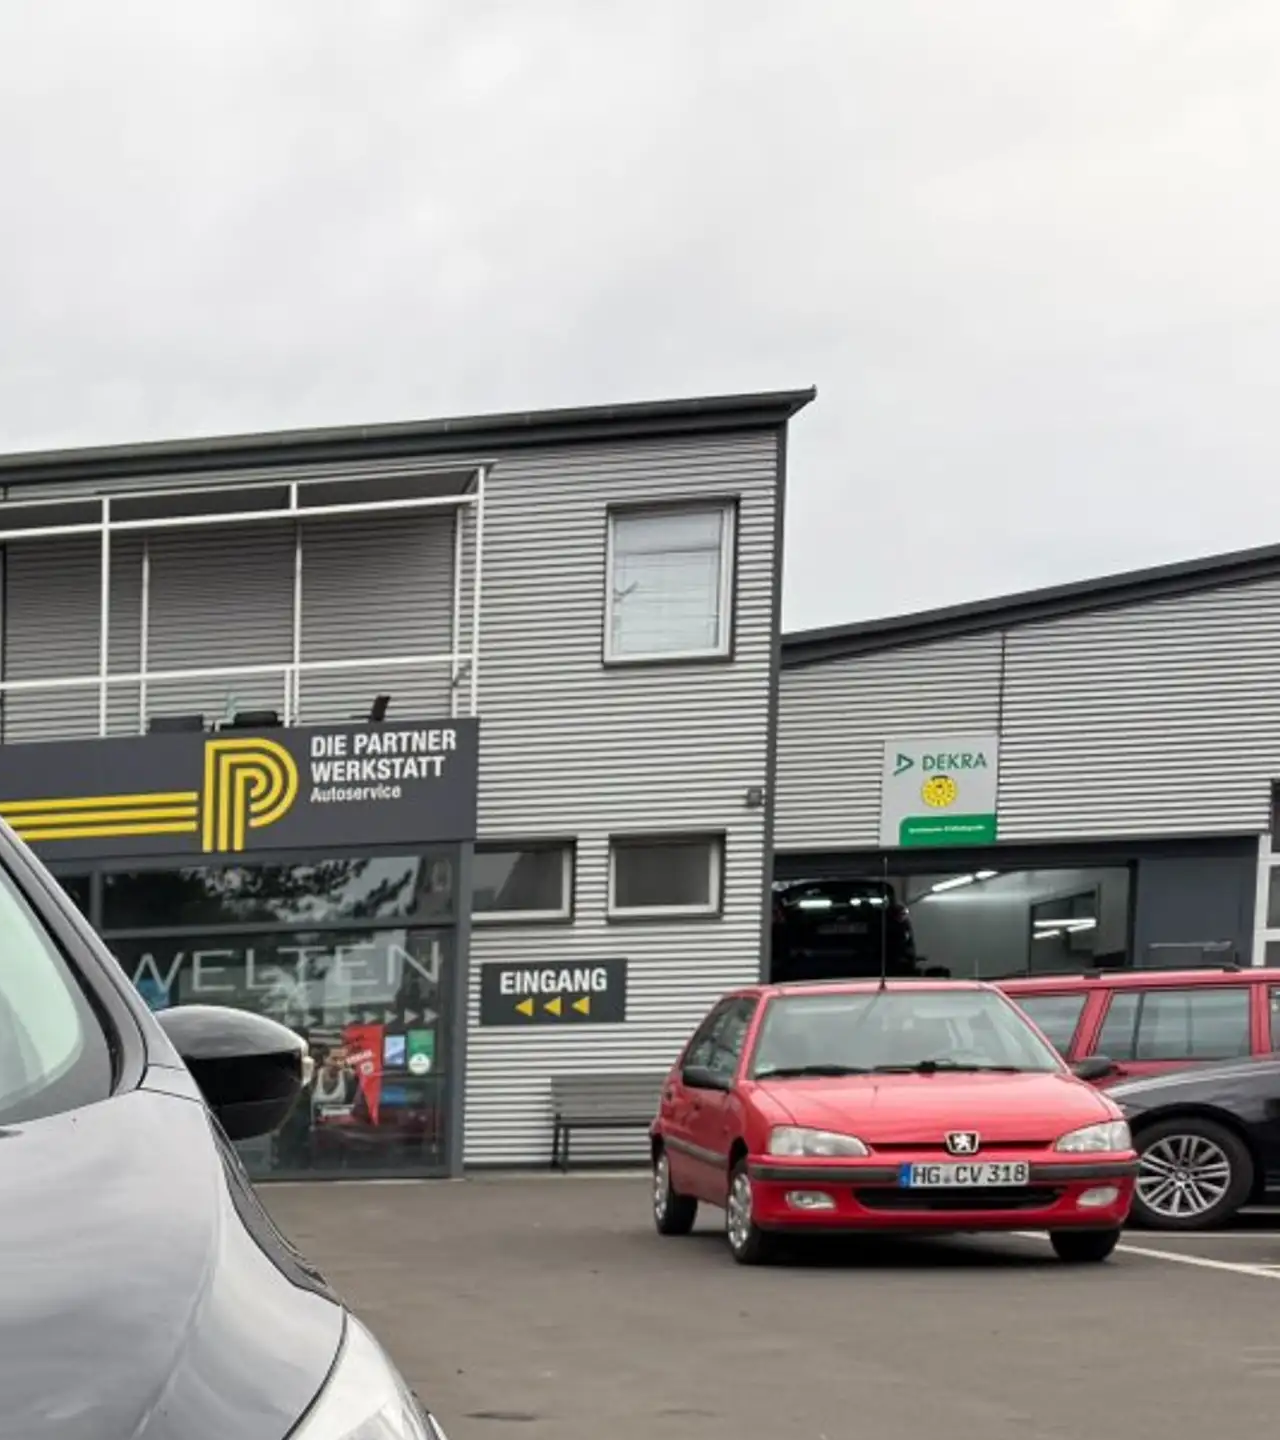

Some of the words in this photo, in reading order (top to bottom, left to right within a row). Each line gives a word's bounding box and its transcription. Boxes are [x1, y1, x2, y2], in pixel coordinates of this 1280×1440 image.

[310, 735, 347, 758] DIE
[353, 729, 456, 755] PARTNER
[310, 756, 445, 784] WERKSTATT
[922, 752, 988, 771] DEKRA
[310, 784, 402, 803] Autoservice
[500, 967, 608, 995] EINGANG
[912, 1166, 941, 1184] HG
[955, 1166, 983, 1183] CV
[988, 1164, 1026, 1183] 318
